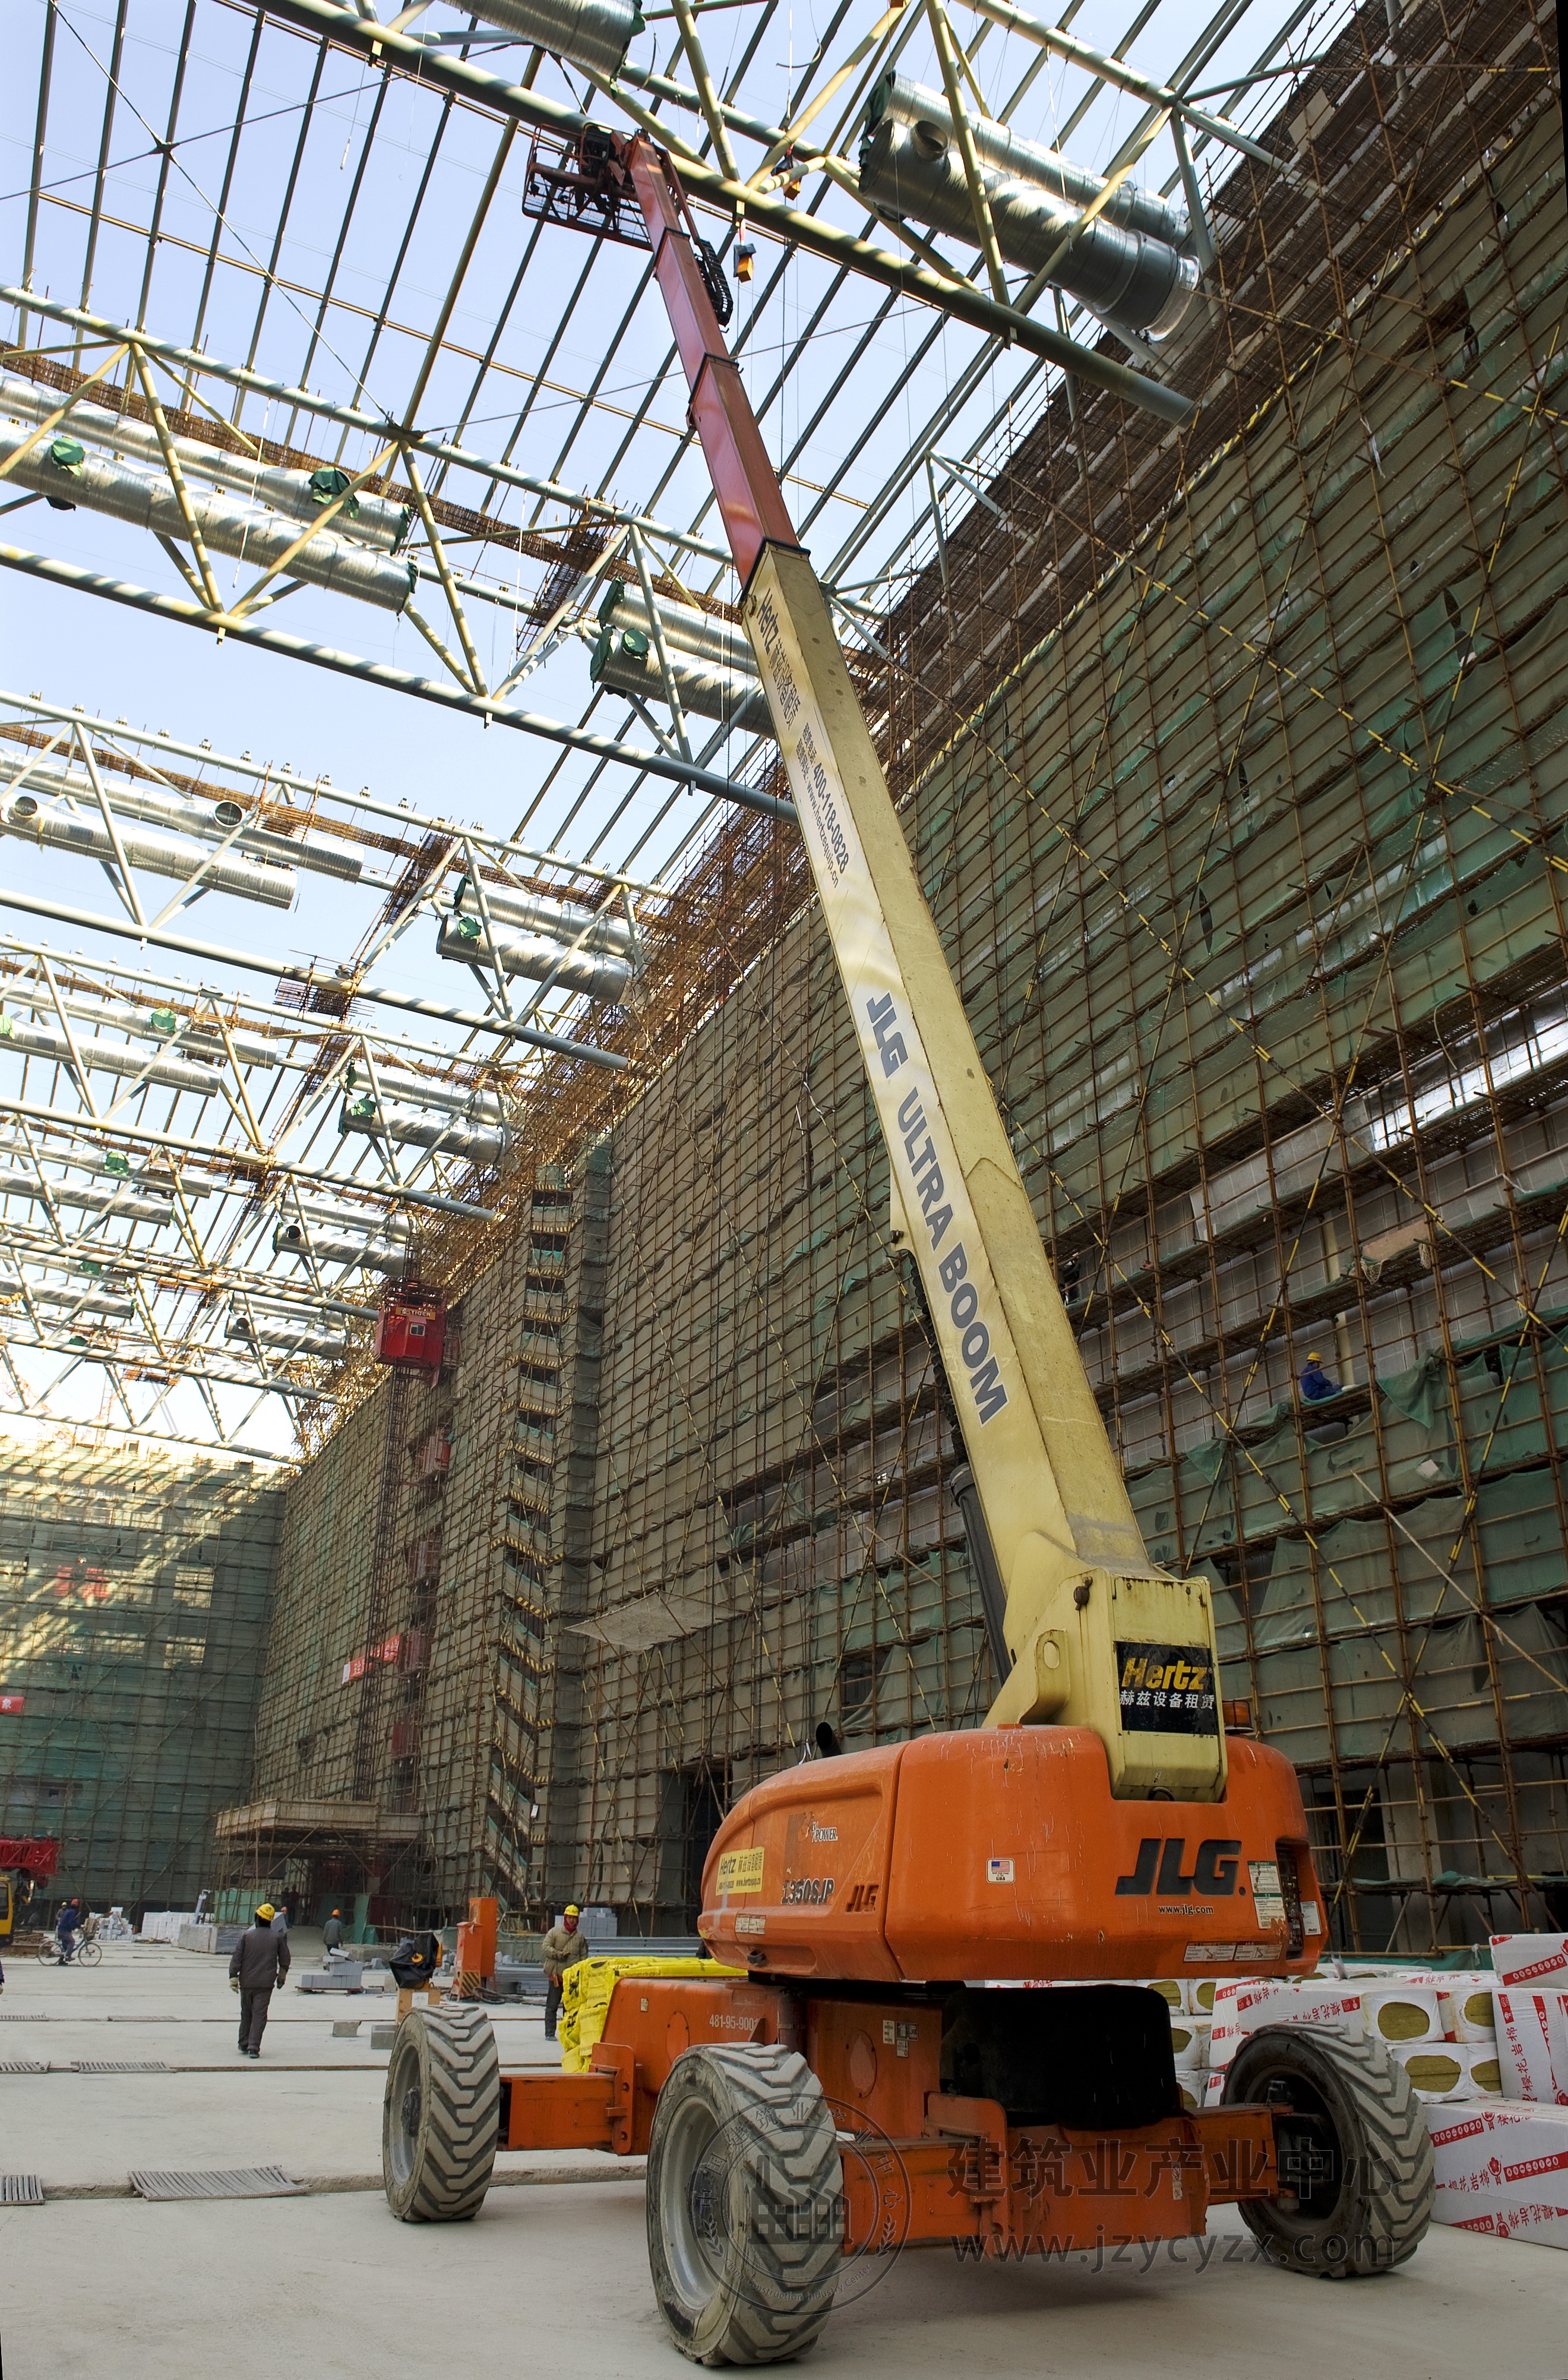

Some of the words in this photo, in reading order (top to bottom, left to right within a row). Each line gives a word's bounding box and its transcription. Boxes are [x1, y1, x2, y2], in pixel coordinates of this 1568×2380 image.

[757, 588, 779, 655] Hertz
[807, 781, 839, 889] www.hertzequip.cn
[813, 762, 849, 875] 400-118-0828
[866, 989, 907, 1077] JLG
[897, 1087, 954, 1249] ULTRA
[939, 1242, 1009, 1427] BOOM
[1121, 1658, 1207, 1690] Hertz
[1120, 1690, 1215, 1709] 赫兹设备租赁
[719, 1856, 736, 1876] Hertz
[1115, 1838, 1240, 1895] JLG
[845, 1885, 880, 1912] JLG
[1158, 1904, 1214, 1917] www.jlg.com
